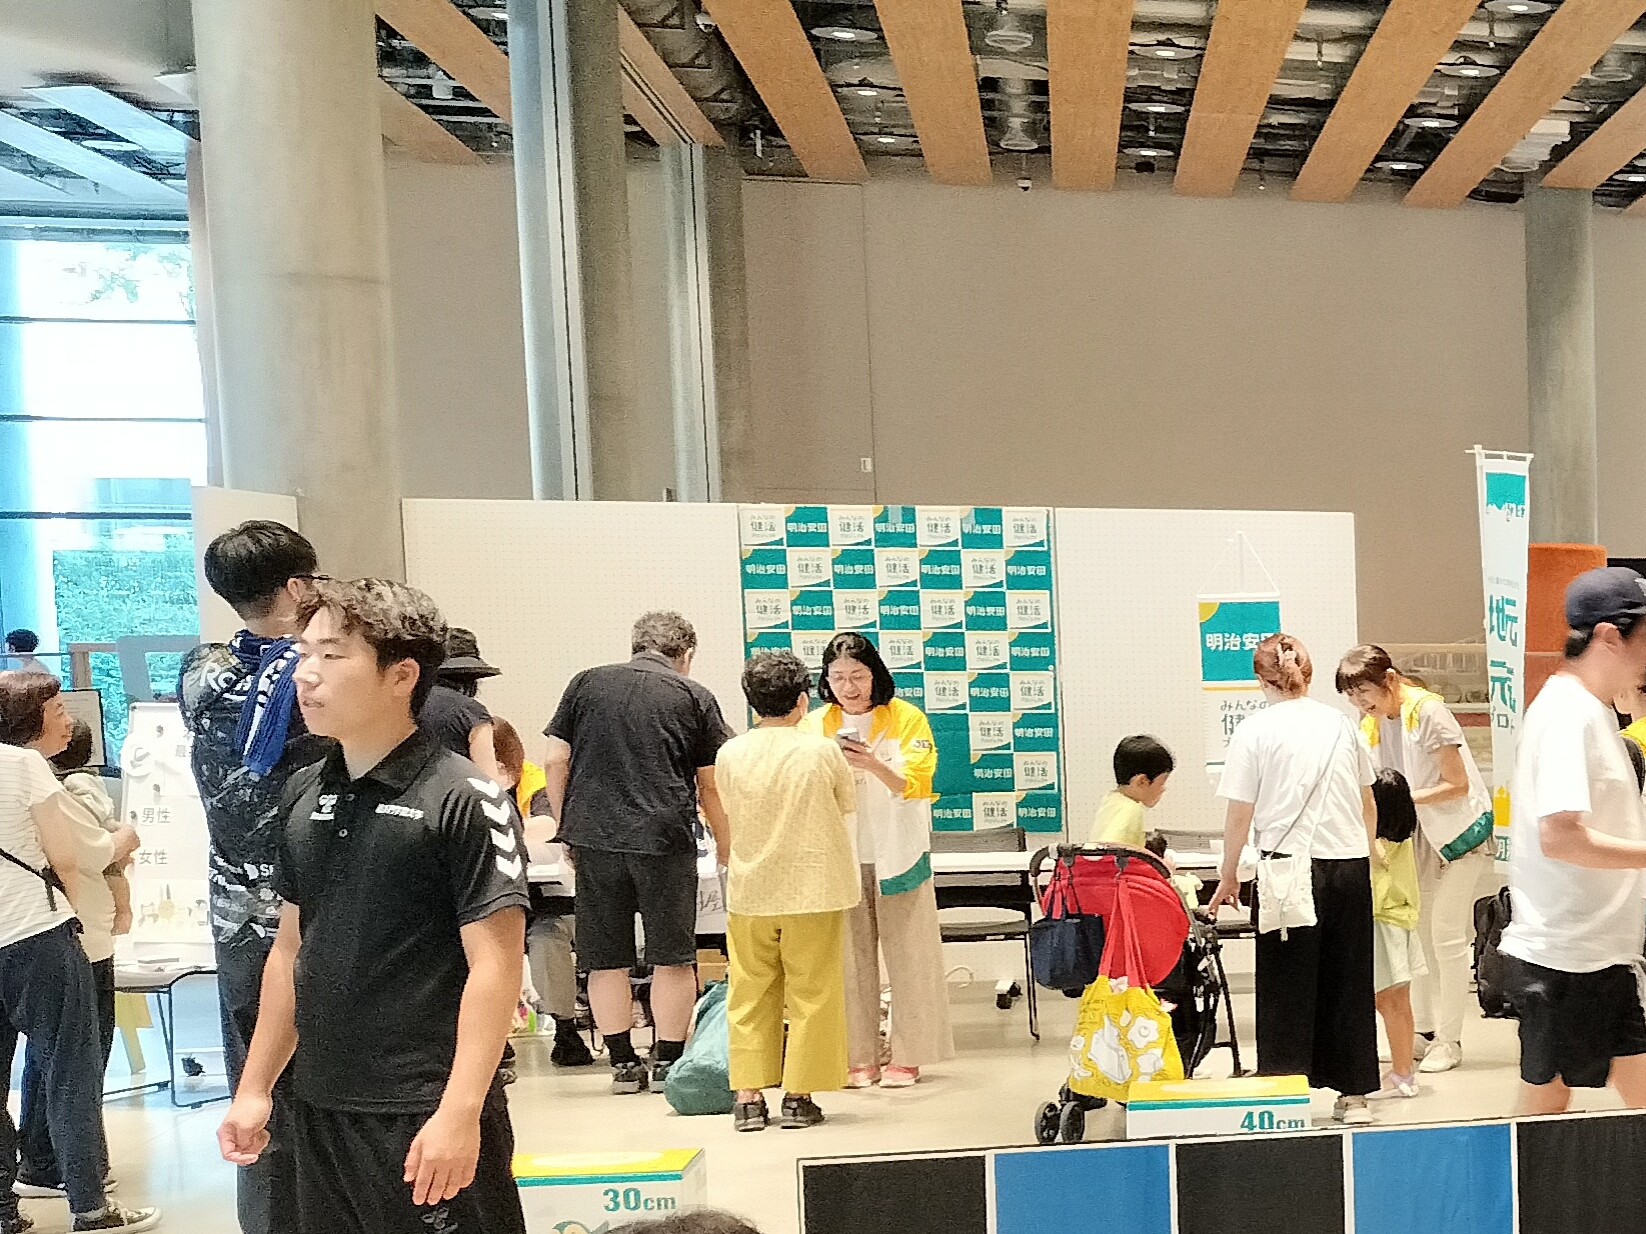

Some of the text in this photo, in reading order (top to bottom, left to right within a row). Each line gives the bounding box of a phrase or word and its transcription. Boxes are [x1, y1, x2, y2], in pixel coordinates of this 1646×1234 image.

[750, 522, 775, 531] 健活
[787, 523, 827, 532] 明治安田
[839, 522, 863, 532] 健活
[875, 523, 915, 533] 明治安田
[927, 523, 950, 533] 健活
[962, 524, 1001, 534] 明治安田
[1013, 524, 1036, 533] 健活
[746, 564, 786, 574] 明治安田
[798, 563, 823, 573] 健活
[832, 565, 874, 574] 明治安田
[886, 563, 910, 573] 健活
[920, 565, 960, 574] 明治安田
[972, 565, 997, 574] 健活
[1007, 566, 1046, 575] 明治安田
[756, 605, 781, 614] 健活
[791, 606, 832, 615] 明治安田
[845, 605, 869, 614] 健活
[880, 606, 921, 615] 明治安田
[931, 605, 955, 615] 健活
[966, 606, 1005, 616] 明治安田
[1017, 606, 1041, 615] 健活
[889, 646, 913, 655] 健活
[925, 647, 964, 656] 明治安田
[976, 646, 999, 656] 健活
[1011, 647, 1049, 656] 明治安田
[935, 687, 959, 696] 健活
[970, 688, 1008, 697] 明治安田
[1021, 687, 1045, 697] 健活
[980, 727, 1003, 737] 健活
[1014, 728, 1053, 737] 明治安田
[974, 769, 1012, 778] 明治安田
[1024, 767, 1047, 777] 健活
[142, 807, 171, 824] 男性
[933, 809, 971, 818] 明治安田
[983, 808, 1007, 818] 健活
[1018, 808, 1055, 817] 明治安田
[139, 849, 168, 865] 女性
[1240, 1110, 1305, 1131] 40cm
[603, 1188, 676, 1212] 30cm
